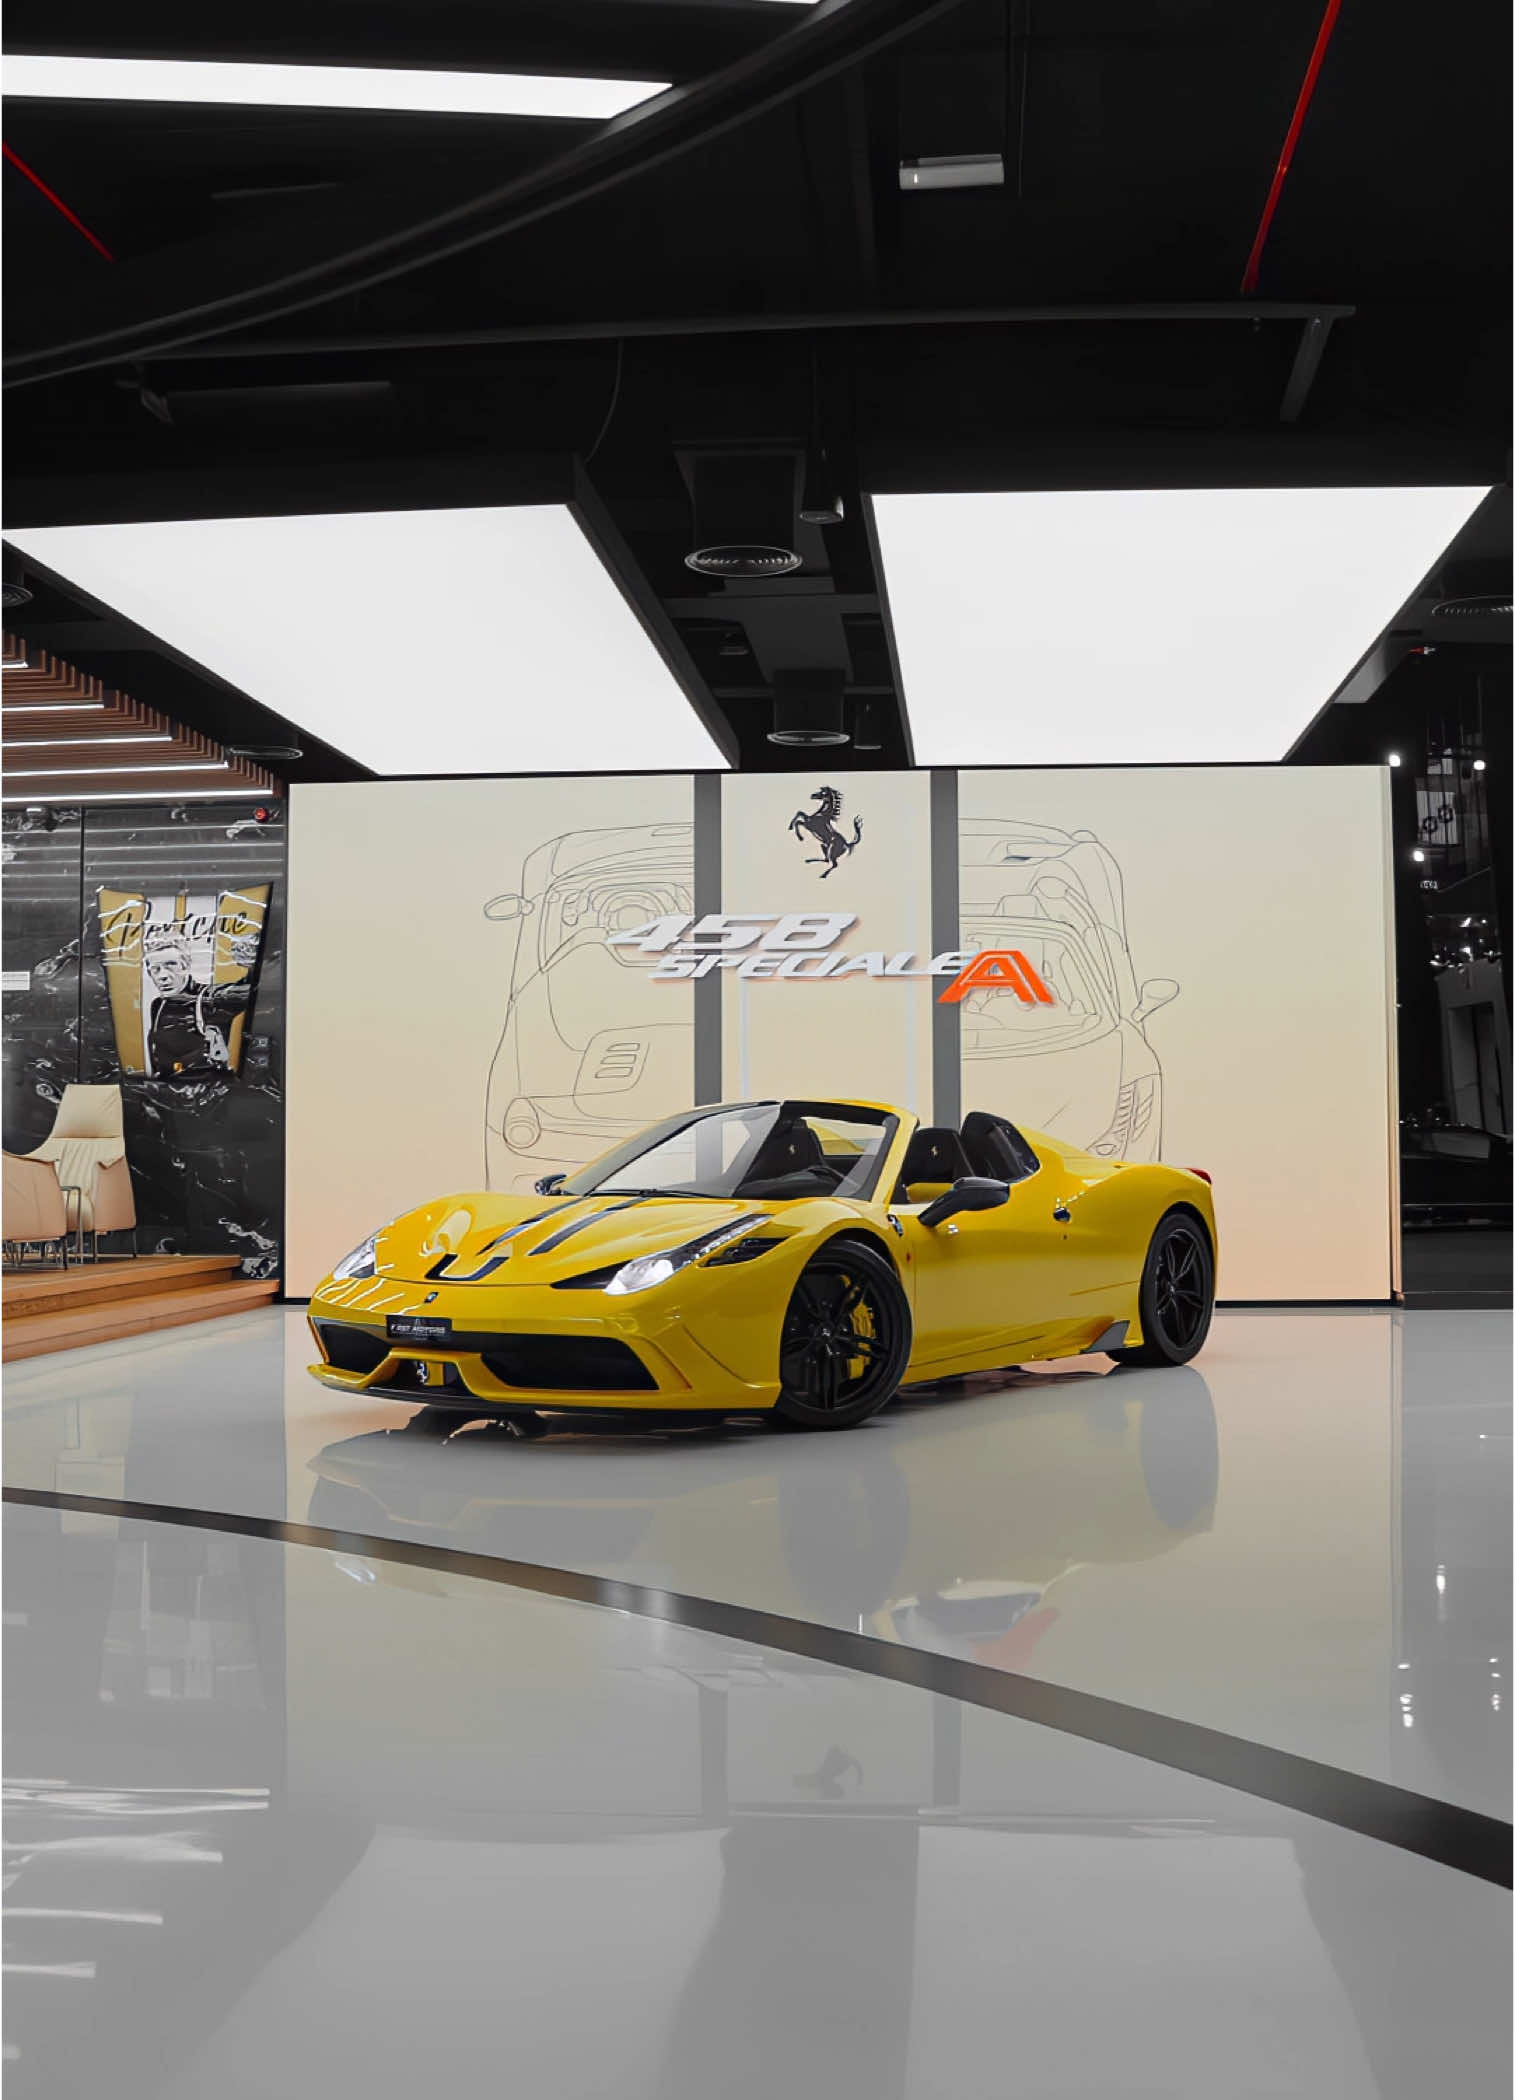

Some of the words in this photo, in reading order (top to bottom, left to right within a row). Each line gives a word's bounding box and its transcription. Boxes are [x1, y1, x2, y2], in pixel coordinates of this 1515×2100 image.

[607, 912, 858, 952] 458
[648, 950, 980, 979] SPECIALE
[937, 949, 1055, 1004] A
